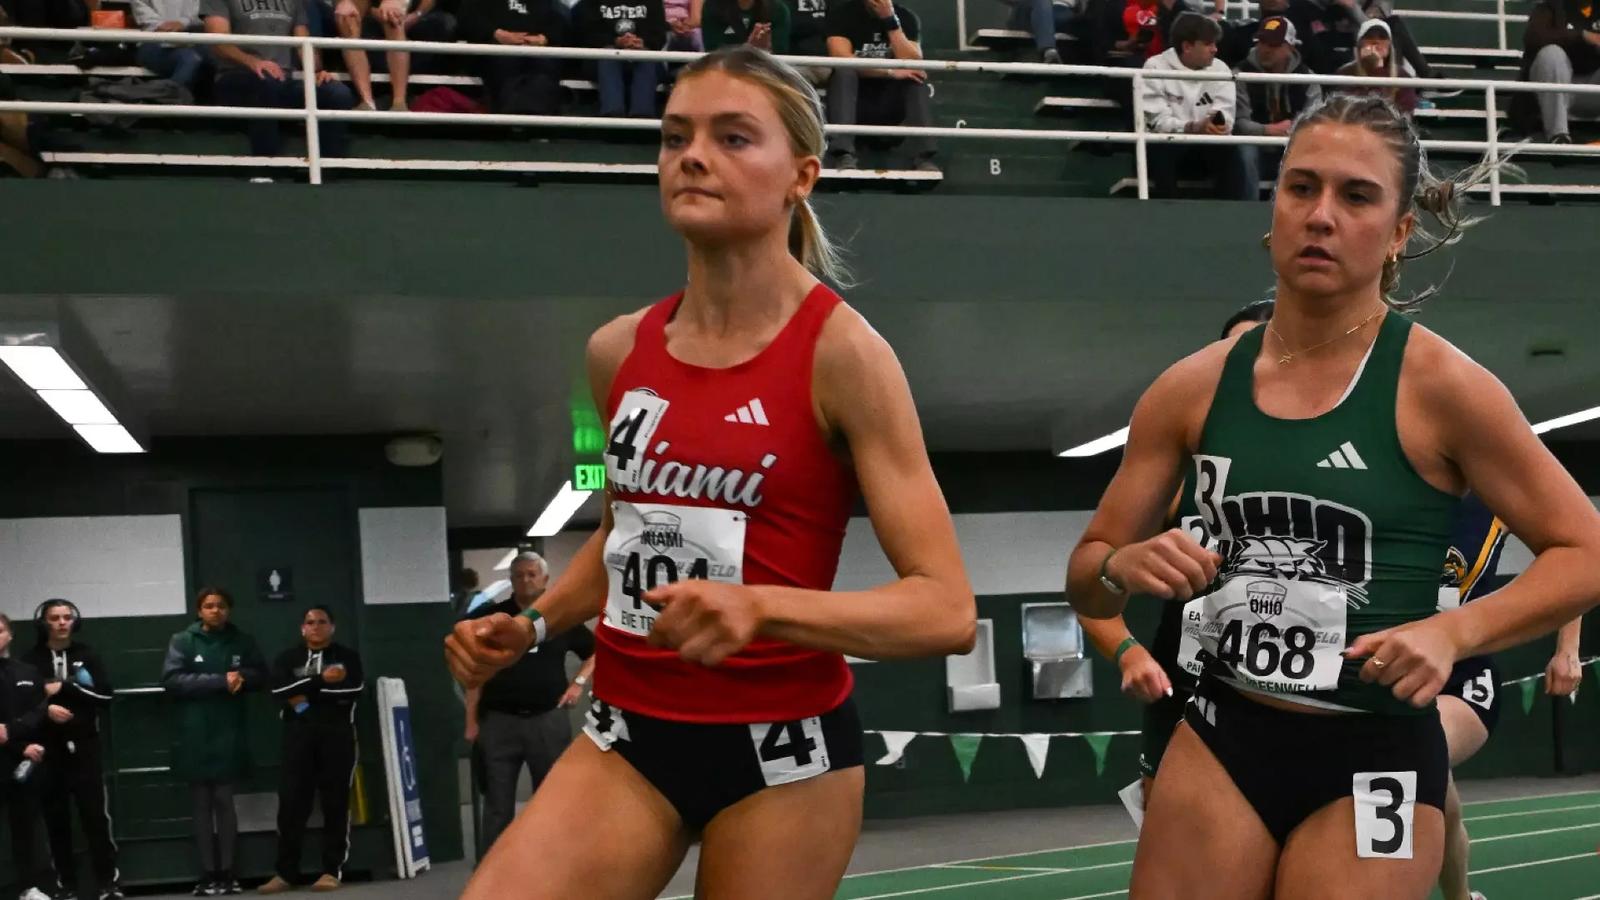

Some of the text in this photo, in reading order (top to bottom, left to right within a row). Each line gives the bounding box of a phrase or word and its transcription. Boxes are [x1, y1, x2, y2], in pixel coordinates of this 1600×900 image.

[990, 158, 1001, 175] B
[606, 408, 648, 471] 4
[612, 440, 777, 508] iami
[1200, 459, 1219, 537] 3
[640, 530, 684, 548] MIAMI
[1250, 598, 1283, 616] OHIO
[1217, 619, 1317, 680] 468
[1471, 670, 1488, 703] 5
[758, 721, 818, 767] 4
[1369, 776, 1405, 855] 3
